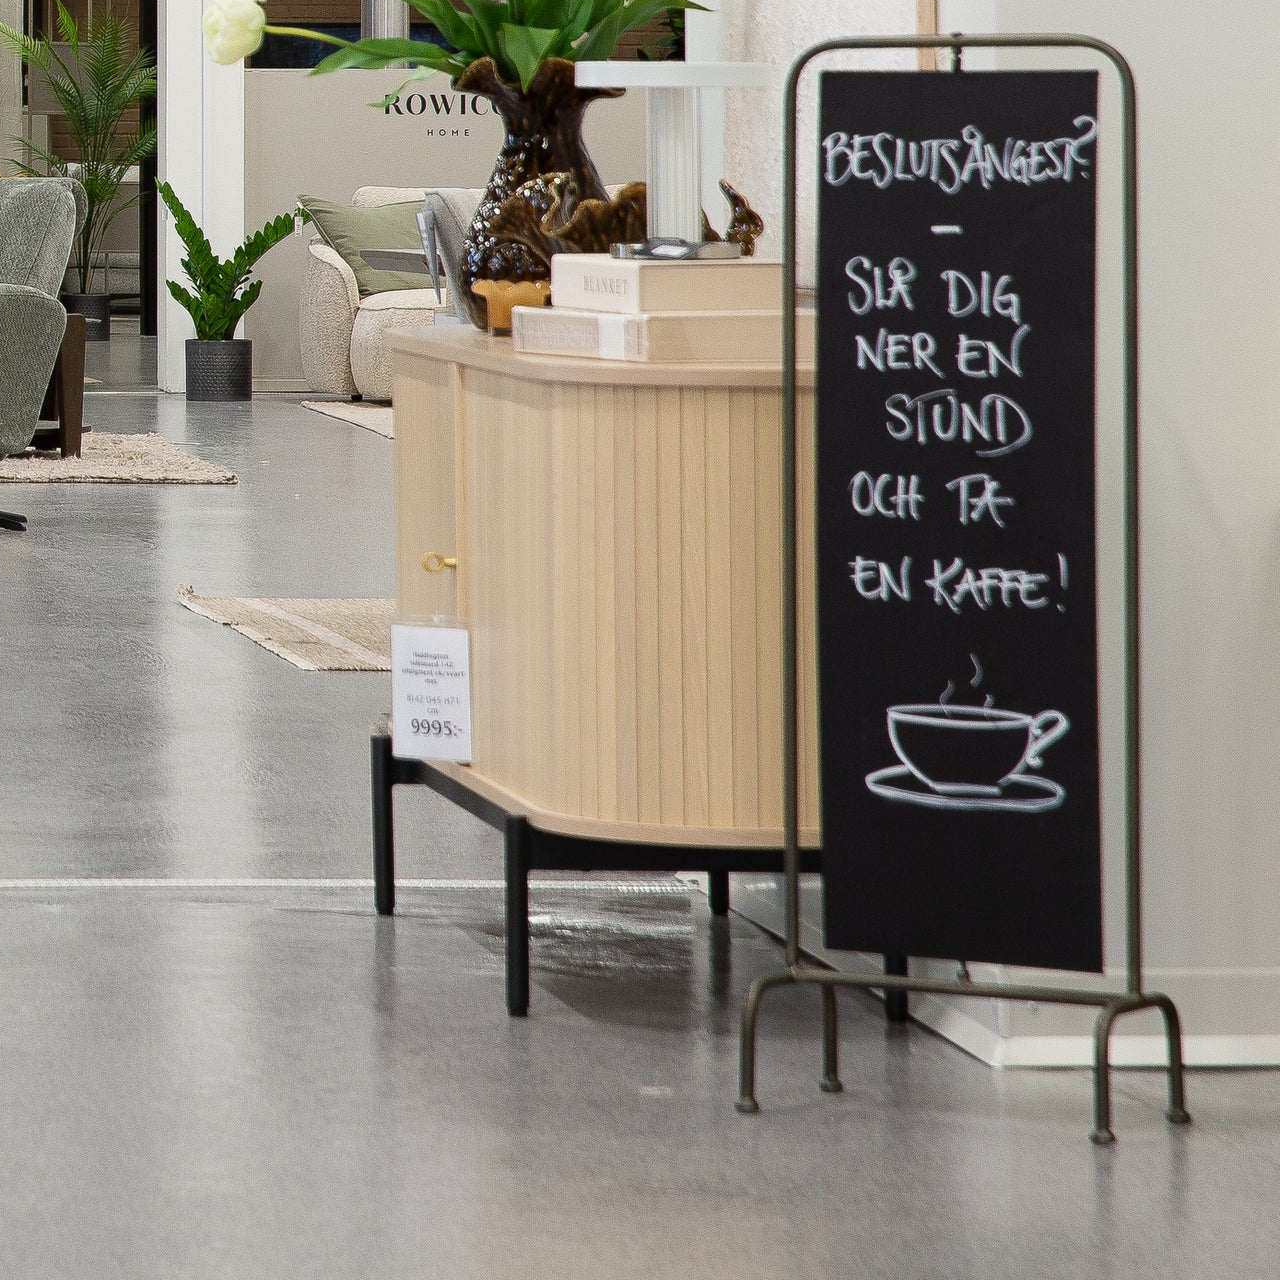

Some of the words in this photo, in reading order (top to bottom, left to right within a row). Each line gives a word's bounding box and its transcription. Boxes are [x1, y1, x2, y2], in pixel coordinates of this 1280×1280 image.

[427, 128, 470, 137] HOME
[822, 115, 1097, 194] BESLUTSÅNGEST?
[940, 270, 1023, 324] DIG
[855, 328, 944, 379] NER
[955, 322, 1032, 378] EN
[886, 389, 1033, 457] STUND
[849, 470, 925, 521] OCH
[945, 473, 1014, 528] TA
[848, 555, 911, 602] EN
[925, 552, 1069, 613] KAFFE!
[410, 718, 463, 737] 9995:-
